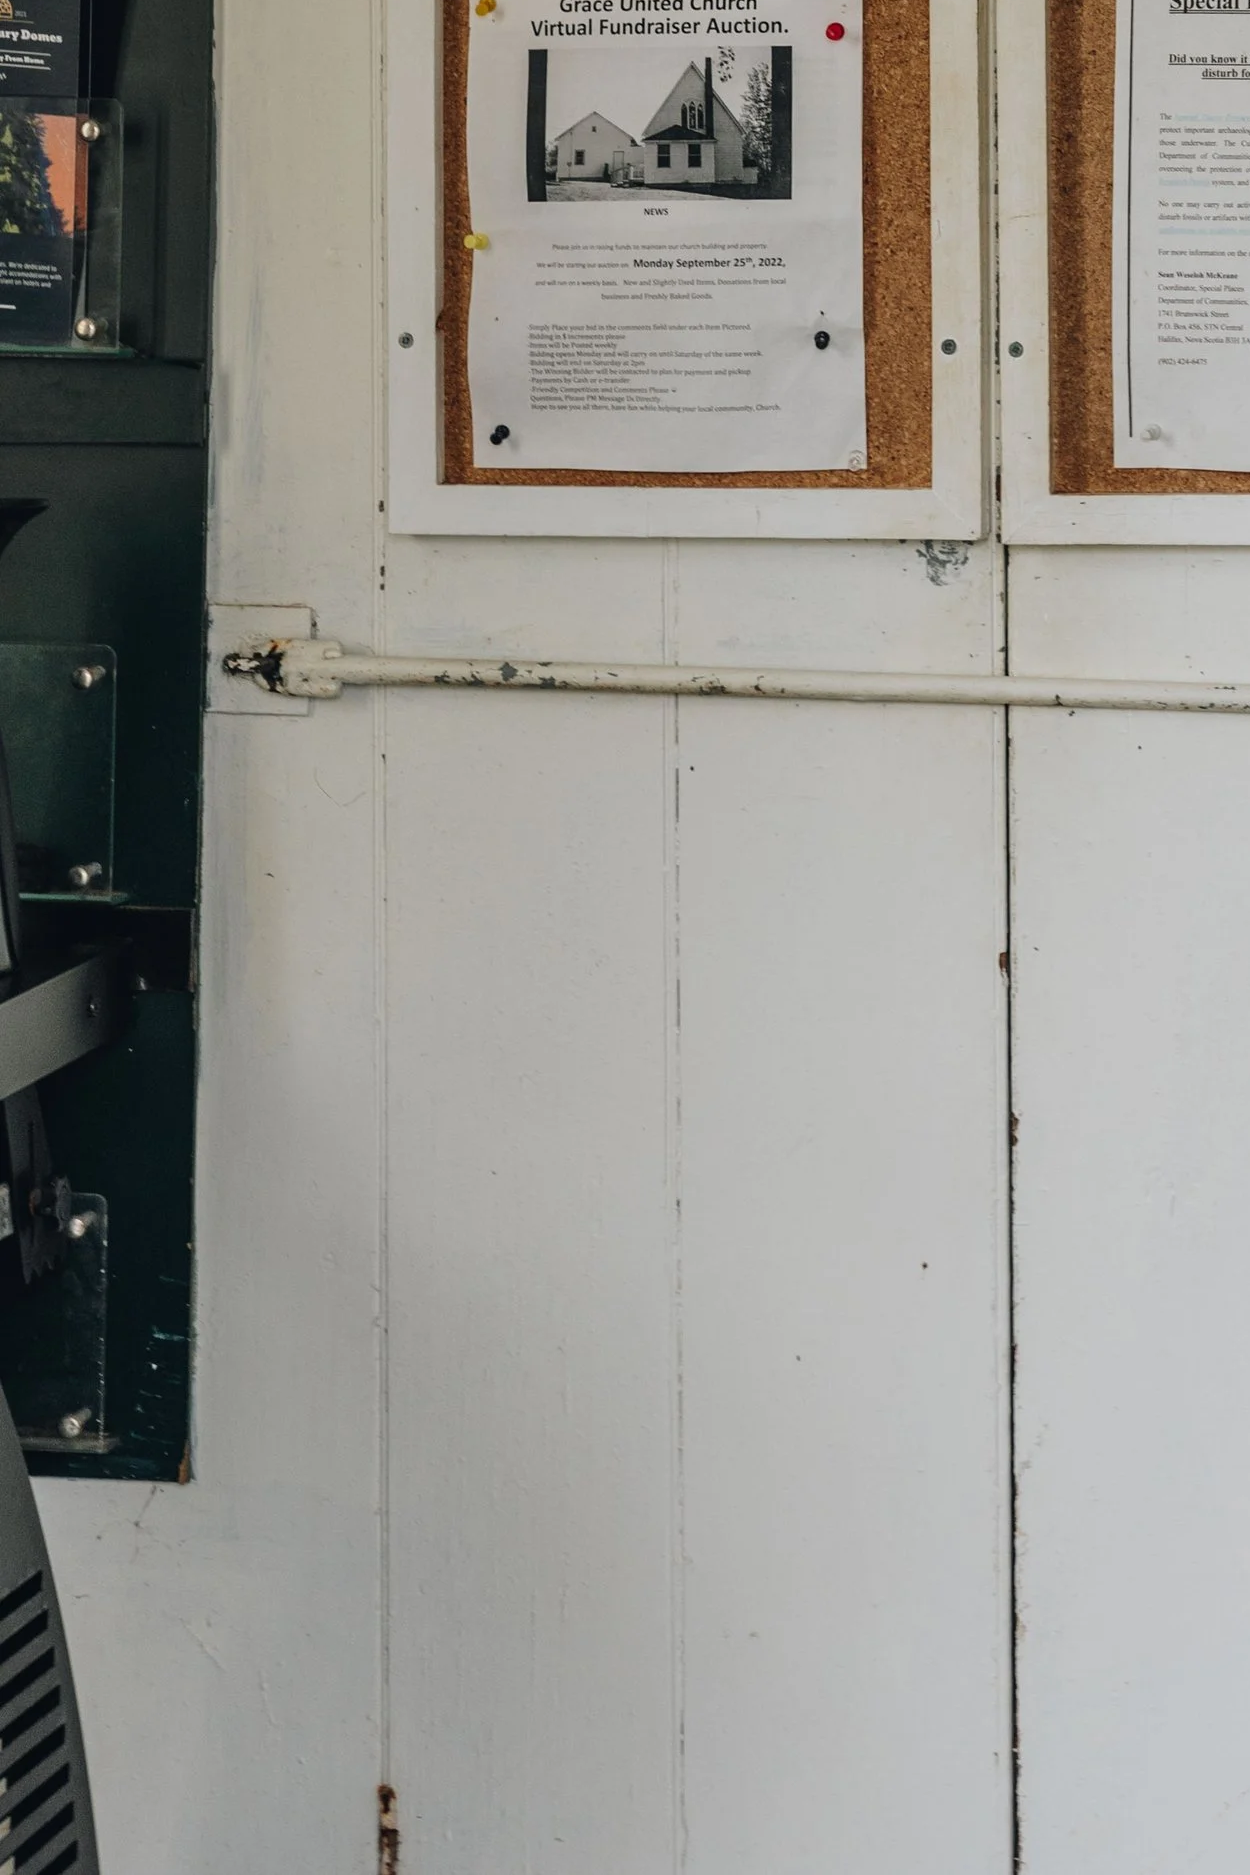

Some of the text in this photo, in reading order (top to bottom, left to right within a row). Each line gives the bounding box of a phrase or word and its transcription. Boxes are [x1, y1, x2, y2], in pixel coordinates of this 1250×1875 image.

[531, 16, 789, 37] Virtual Fundraiser Auction.
[21, 29, 62, 43] Domes
[643, 207, 669, 216] NEWS
[633, 258, 674, 270] Monday
[676, 257, 731, 270] September
[758, 257, 786, 268] 2022,
